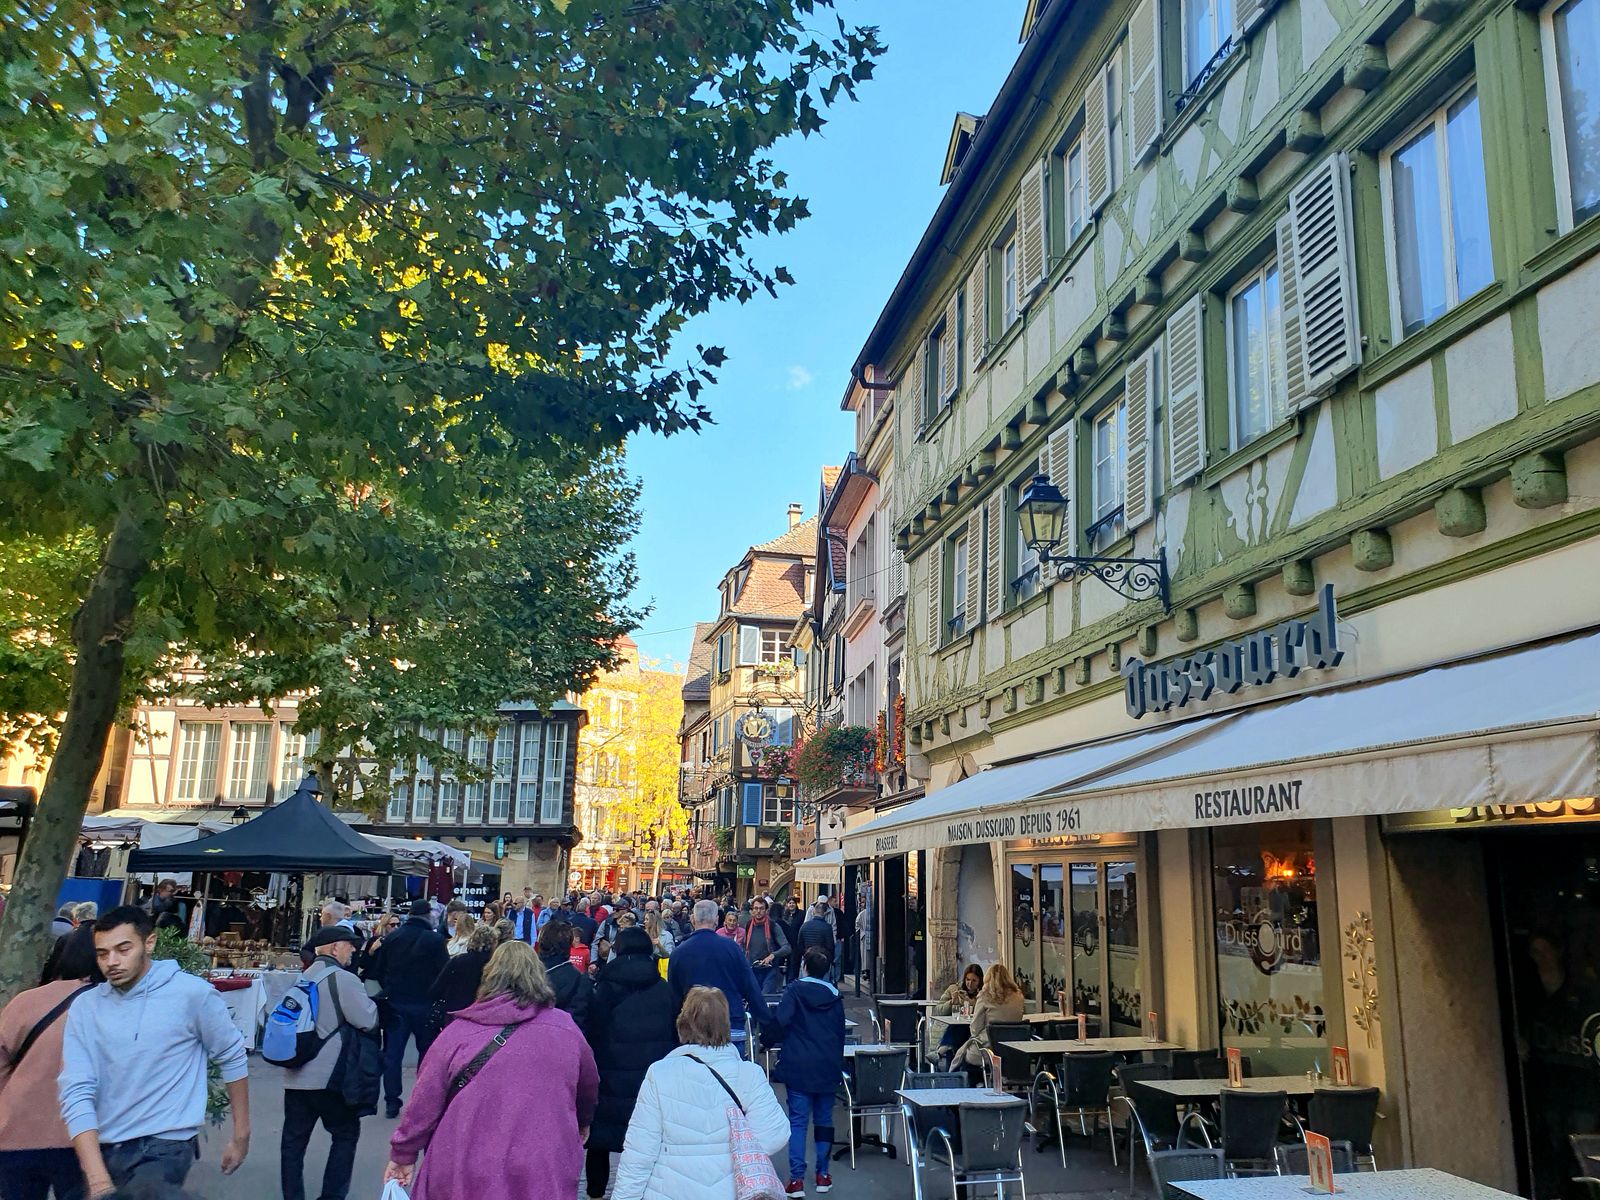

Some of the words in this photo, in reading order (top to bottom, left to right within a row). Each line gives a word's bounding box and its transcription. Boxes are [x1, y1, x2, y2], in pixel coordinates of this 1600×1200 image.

[1195, 780, 1302, 819] RESTAURANT
[948, 823, 973, 842] MAISON
[976, 817, 1015, 838] DUSSOURD
[1020, 811, 1051, 833] DEPUIS
[1056, 807, 1081, 831] 1961
[875, 834, 898, 851] BRASSERIE
[453, 886, 487, 895] ement
